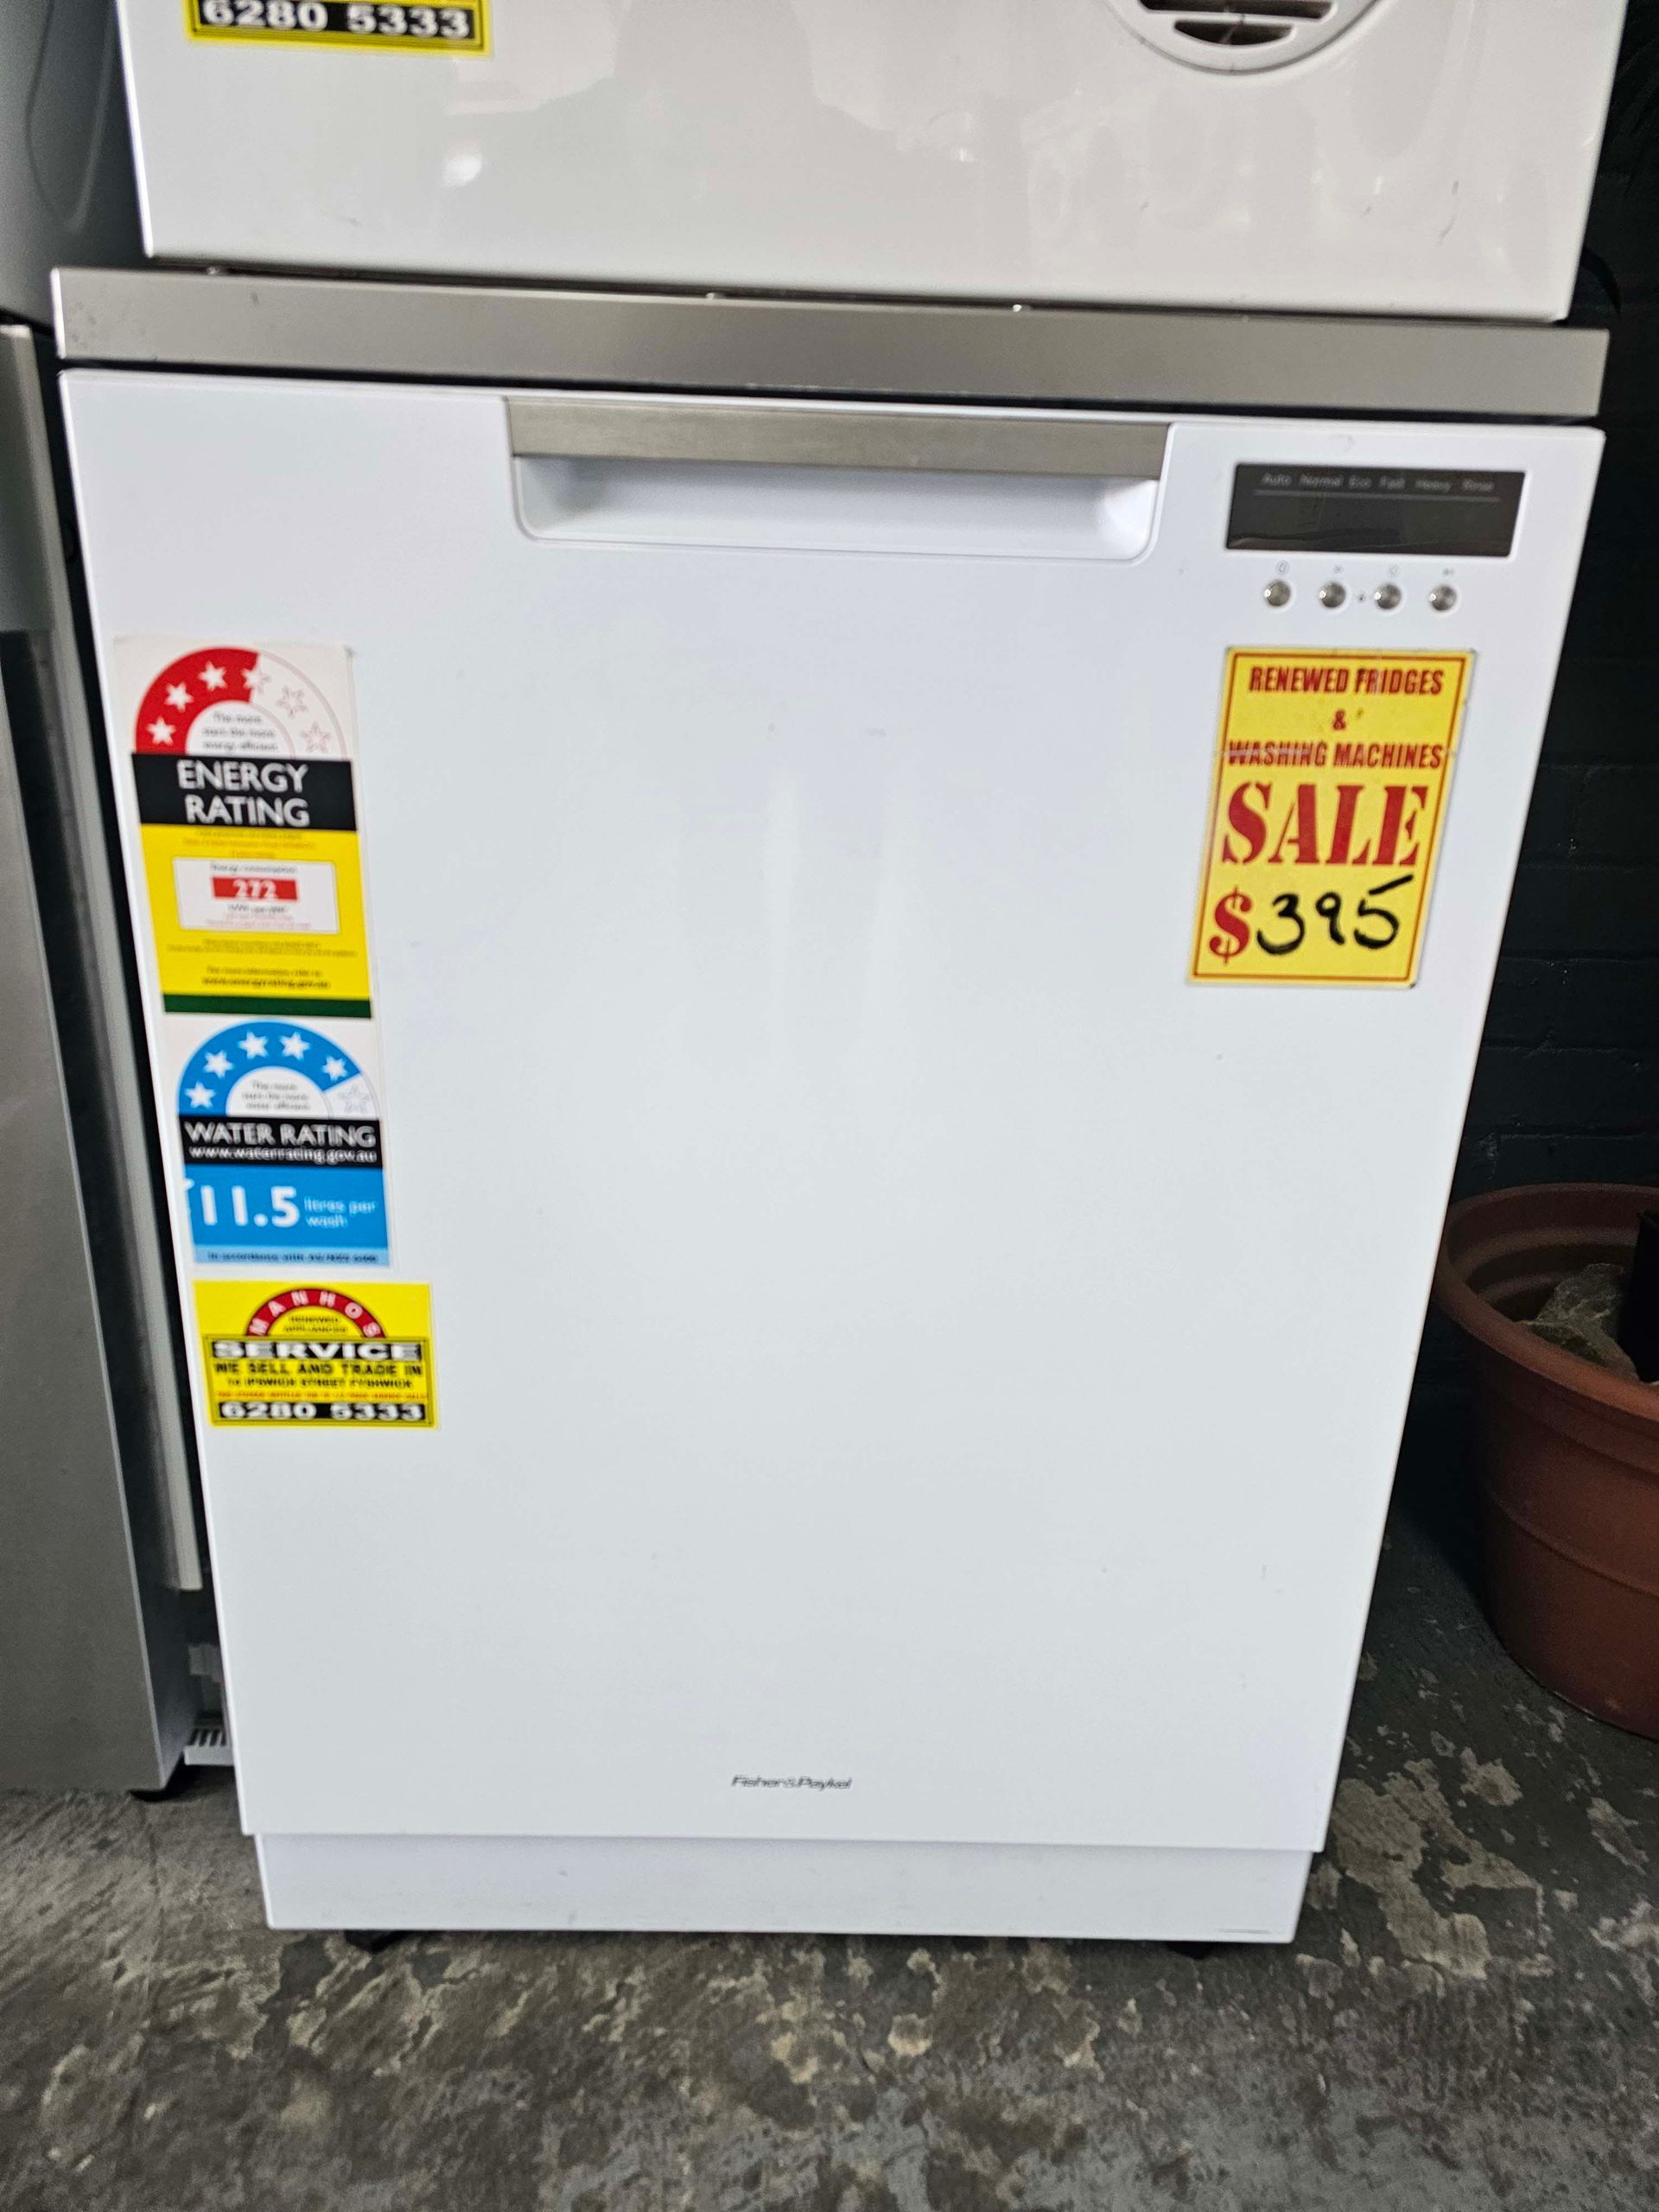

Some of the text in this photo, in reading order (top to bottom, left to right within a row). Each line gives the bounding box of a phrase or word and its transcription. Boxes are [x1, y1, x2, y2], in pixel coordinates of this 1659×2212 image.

[202, 0, 470, 38] 6280 5333
[1249, 666, 1445, 695] RENEWED FRIDGES
[1332, 709, 1347, 731] &
[1228, 741, 1444, 769] WASHING MACHINES
[176, 759, 308, 793] ENERGY
[184, 794, 310, 827] RATING
[1222, 781, 1429, 867] SALE
[184, 1121, 377, 1147] WATER RATING
[188, 1146, 378, 1164] www.waterrating.gov.au
[200, 1185, 376, 1228] 11.5 litres per
[306, 1215, 348, 1228] wash
[249, 1290, 381, 1338] MANHOS
[213, 1342, 422, 1360] SERVICE
[215, 1363, 423, 1376] WE SELL AND TRADE IN
[220, 1402, 423, 1421] 6280 5333
